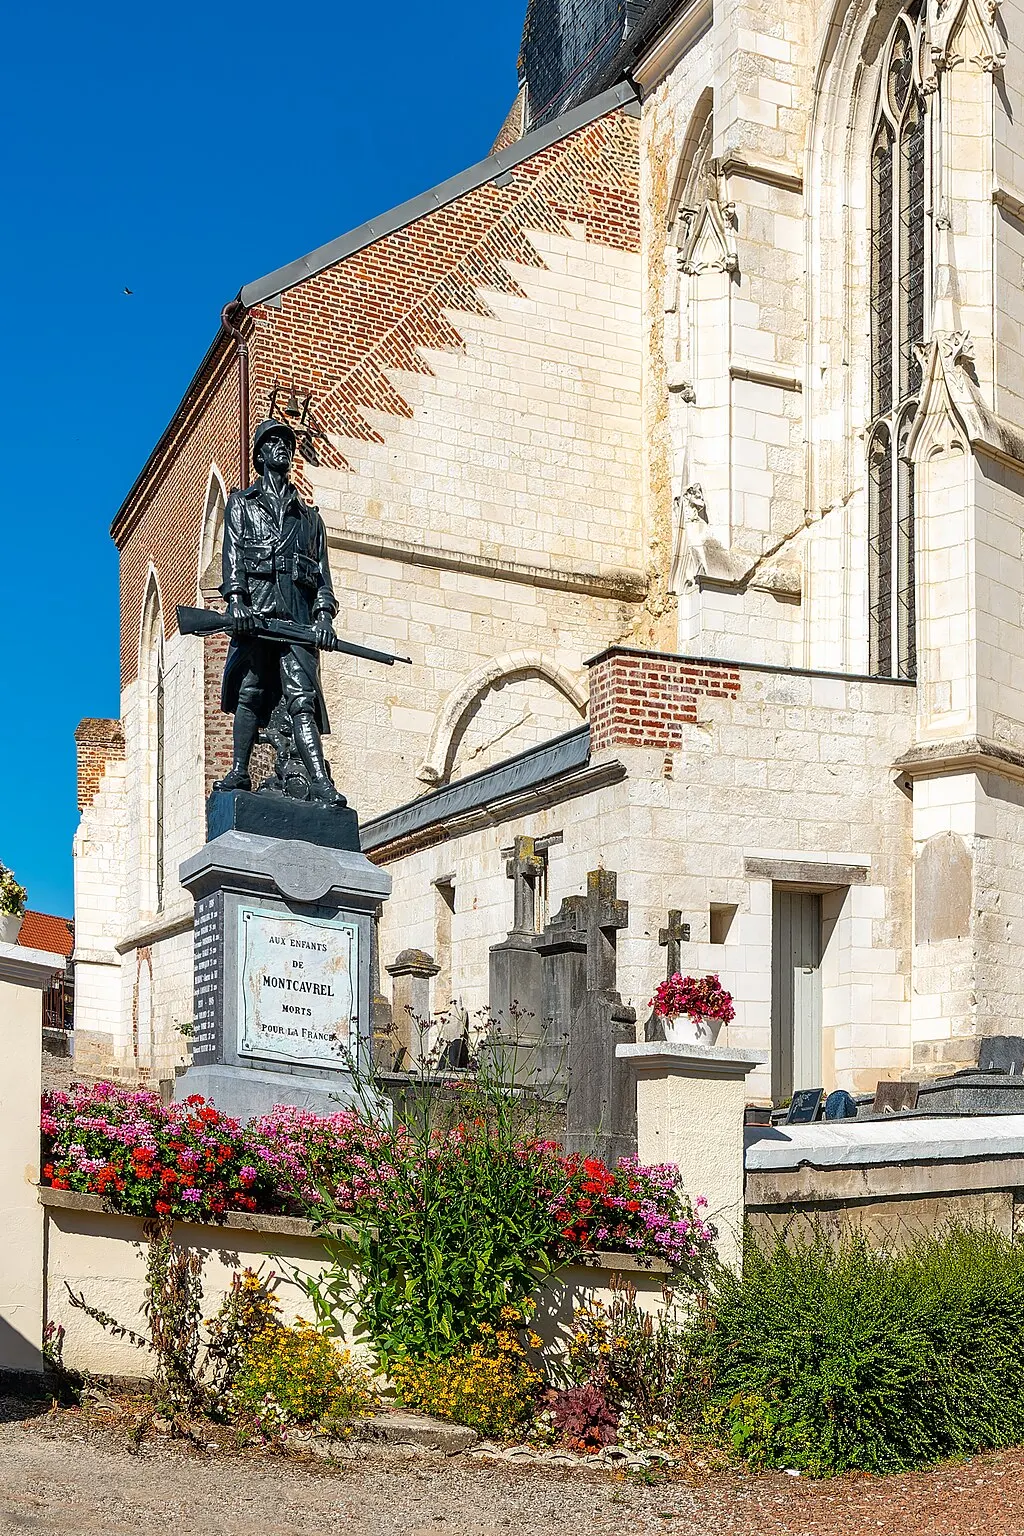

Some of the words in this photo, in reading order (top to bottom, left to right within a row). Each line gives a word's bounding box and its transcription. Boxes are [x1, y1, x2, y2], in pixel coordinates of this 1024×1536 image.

[269, 936, 286, 945] AUX
[290, 939, 328, 952] ENFANTS
[292, 960, 304, 969] DE
[262, 975, 335, 997] MONTCAVREL
[282, 1004, 312, 1016] MORTS
[261, 1024, 285, 1035] POUR
[287, 1028, 299, 1037] LA
